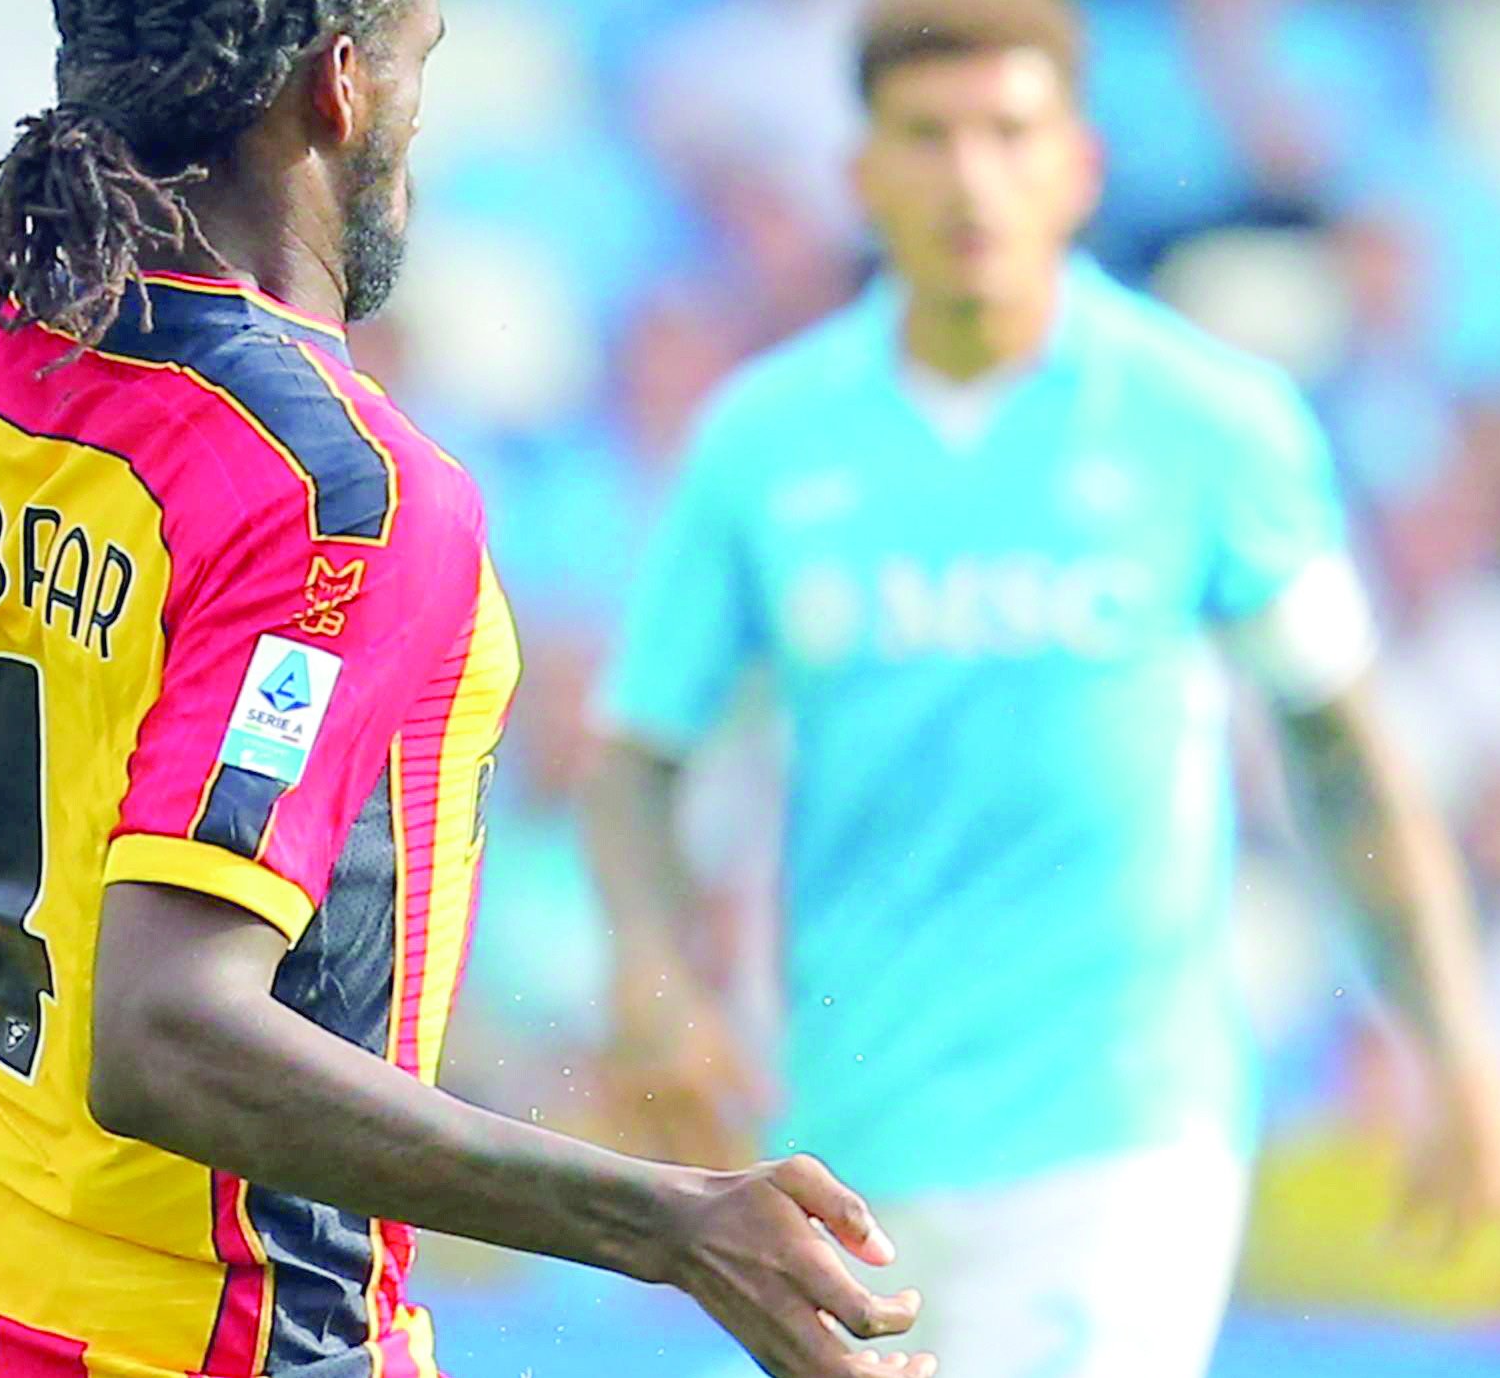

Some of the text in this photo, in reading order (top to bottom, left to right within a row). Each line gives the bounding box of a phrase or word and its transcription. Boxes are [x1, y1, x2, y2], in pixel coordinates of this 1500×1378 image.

[873, 552, 1160, 662] MSC
[246, 708, 304, 736] SERIE A
